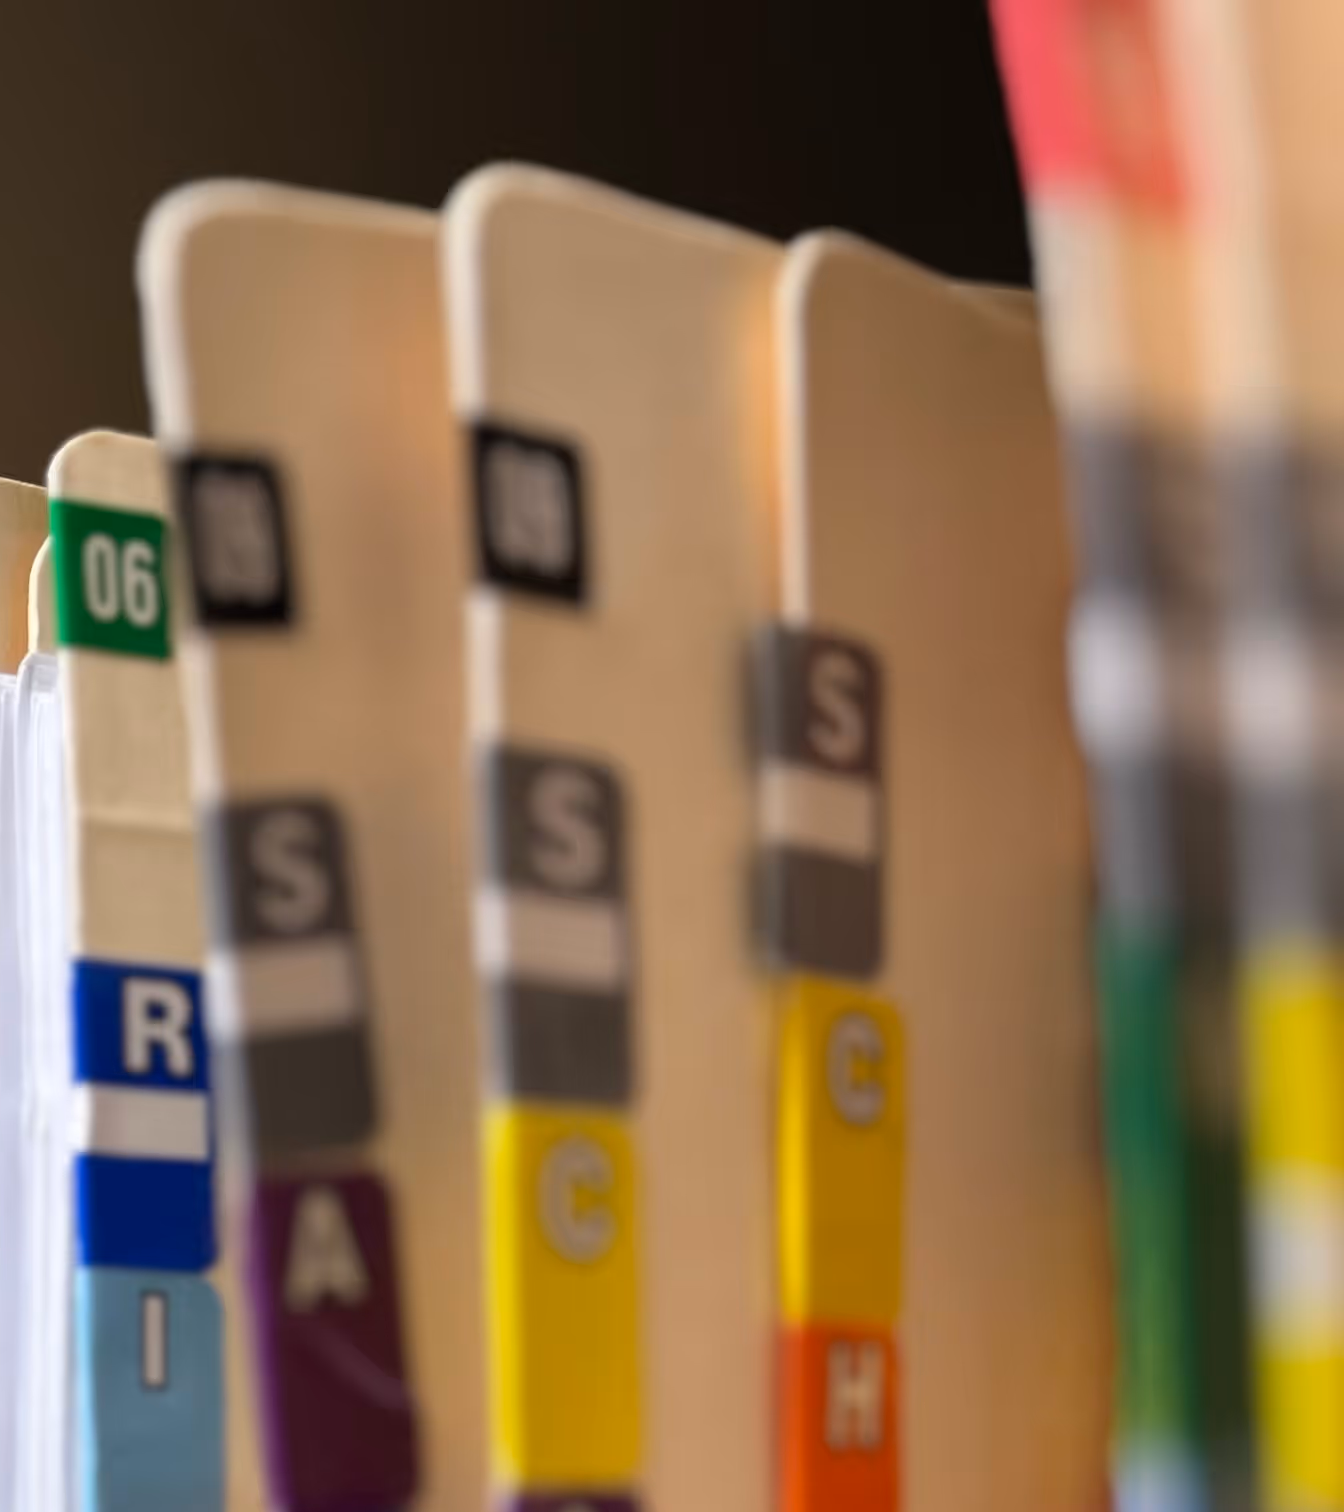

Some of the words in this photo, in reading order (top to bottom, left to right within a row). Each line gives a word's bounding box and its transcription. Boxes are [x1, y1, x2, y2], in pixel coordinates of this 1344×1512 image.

[82, 533, 159, 627] 06
[805, 652, 866, 767] S
[249, 808, 331, 931] S
[528, 767, 610, 888] S
[121, 974, 196, 1077] R
[827, 1013, 885, 1127] C
[282, 1185, 369, 1314] A
[539, 1133, 617, 1262] C
[141, 1290, 169, 1392] I
[824, 1341, 885, 1452] H
